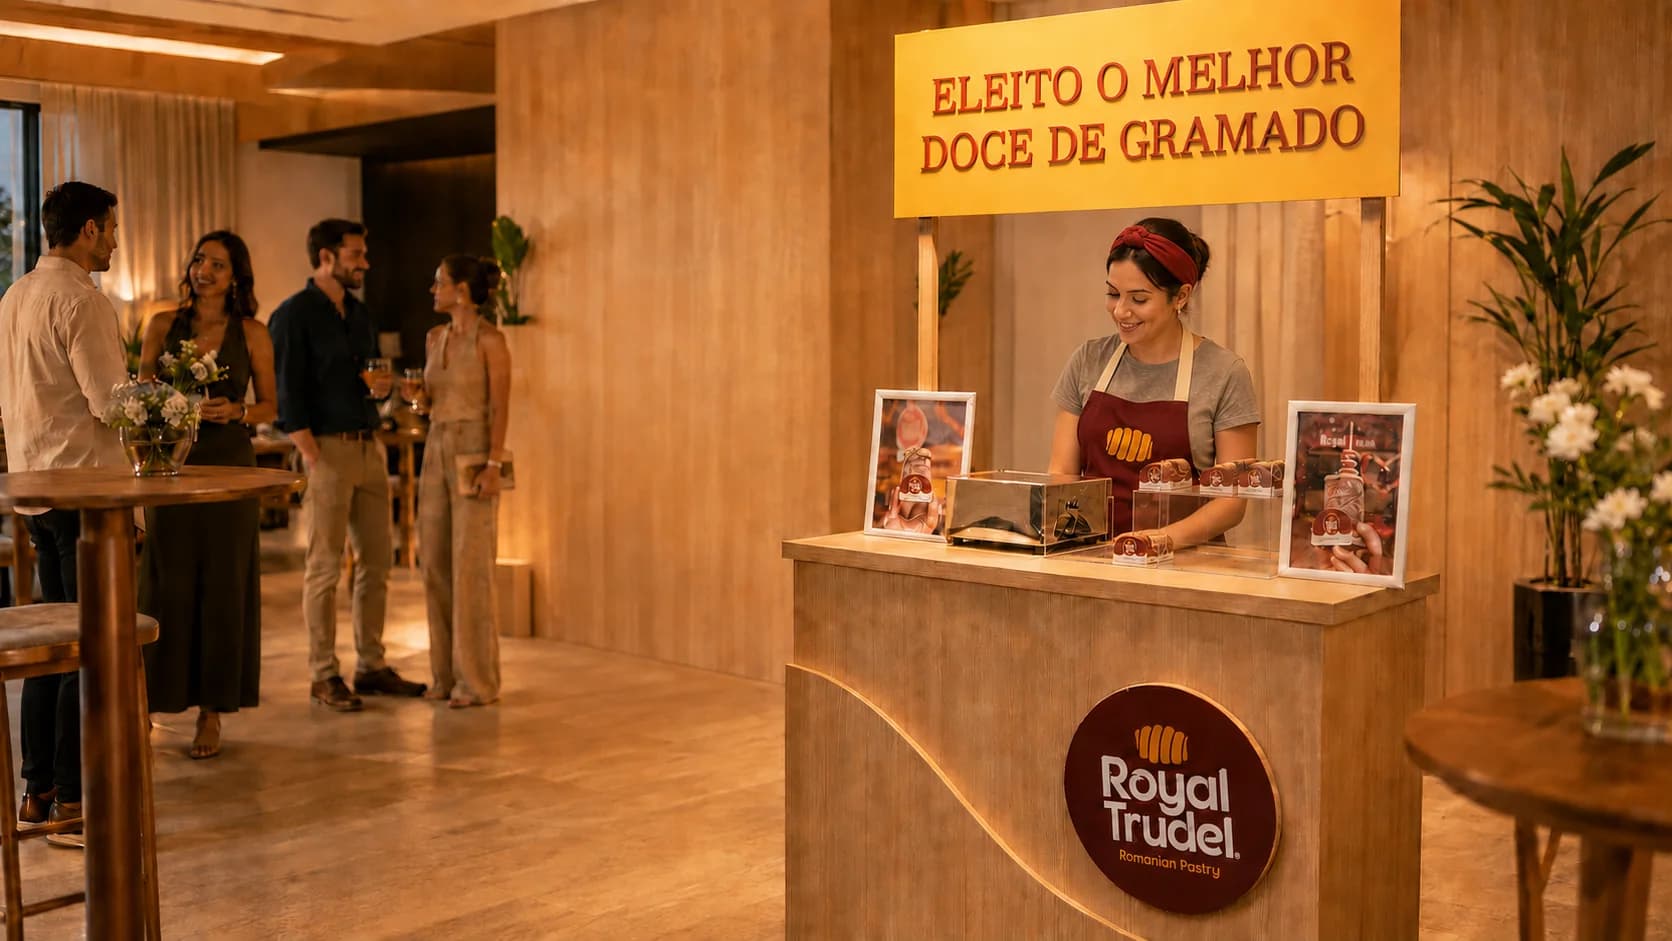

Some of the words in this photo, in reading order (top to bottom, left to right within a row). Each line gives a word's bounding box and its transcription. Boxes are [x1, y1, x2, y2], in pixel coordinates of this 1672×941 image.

[932, 65, 1083, 115] ELEITO
[1097, 61, 1128, 102] O
[1143, 41, 1354, 98] MELHOR
[921, 129, 1034, 173] DOCE
[1048, 123, 1106, 166] DE
[1120, 104, 1366, 162] GRAMADO
[1101, 755, 1231, 816] Royal
[1104, 800, 1235, 859] Trudel
[1119, 849, 1177, 869] Romanian
[1179, 860, 1220, 879] Pastry
